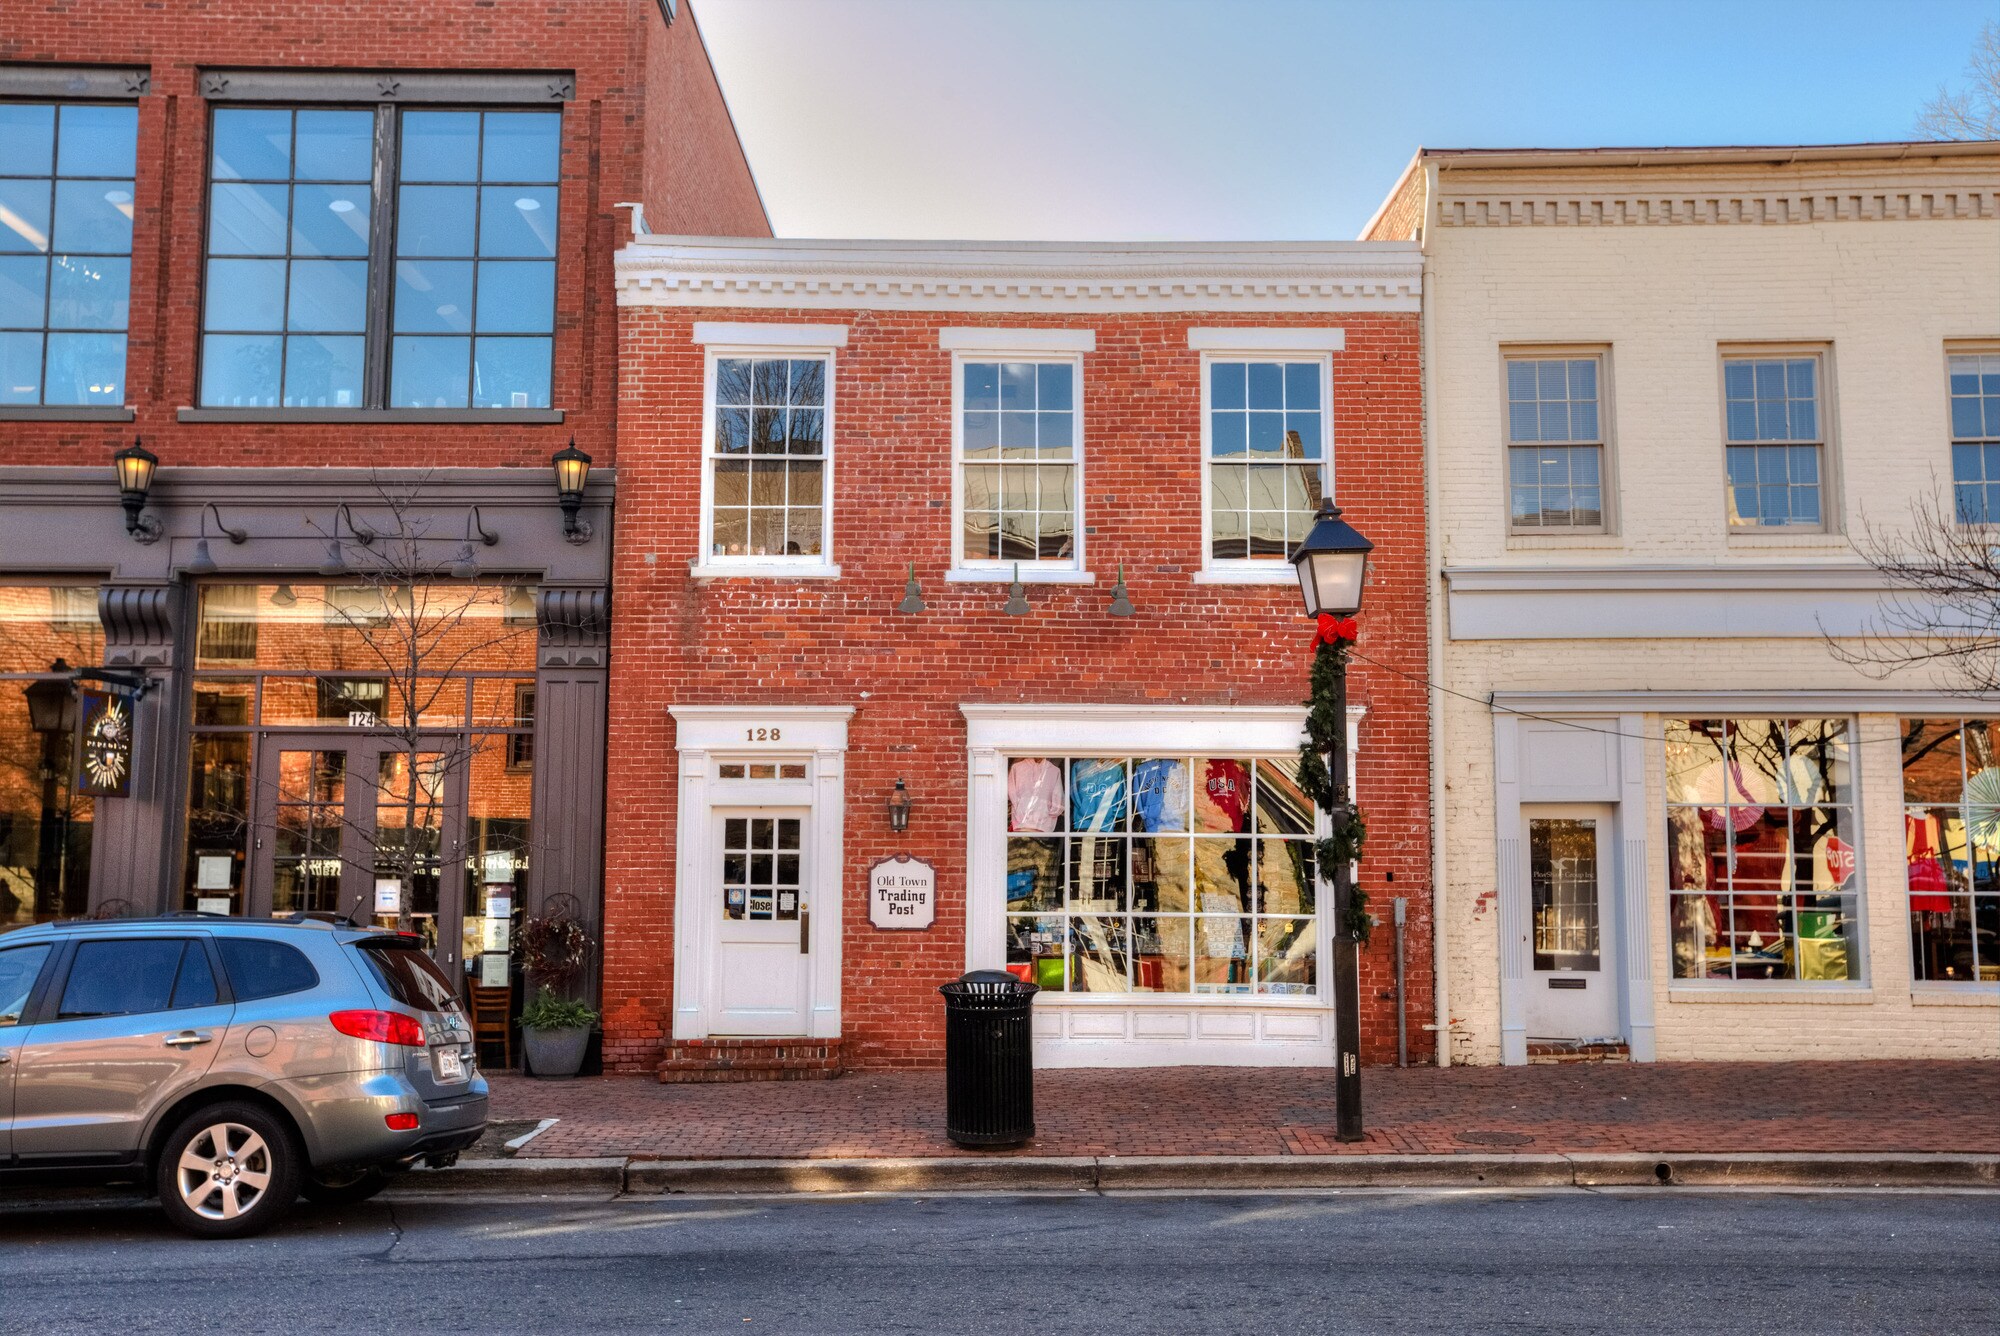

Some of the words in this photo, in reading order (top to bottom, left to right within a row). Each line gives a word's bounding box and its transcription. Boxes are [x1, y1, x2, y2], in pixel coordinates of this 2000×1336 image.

[351, 712, 374, 726] 124
[747, 728, 780, 741] 128
[1208, 778, 1235, 791] USA
[877, 876, 895, 886] Old
[899, 876, 927, 886] Town
[878, 889, 926, 904] Trading
[888, 903, 914, 915] Post
